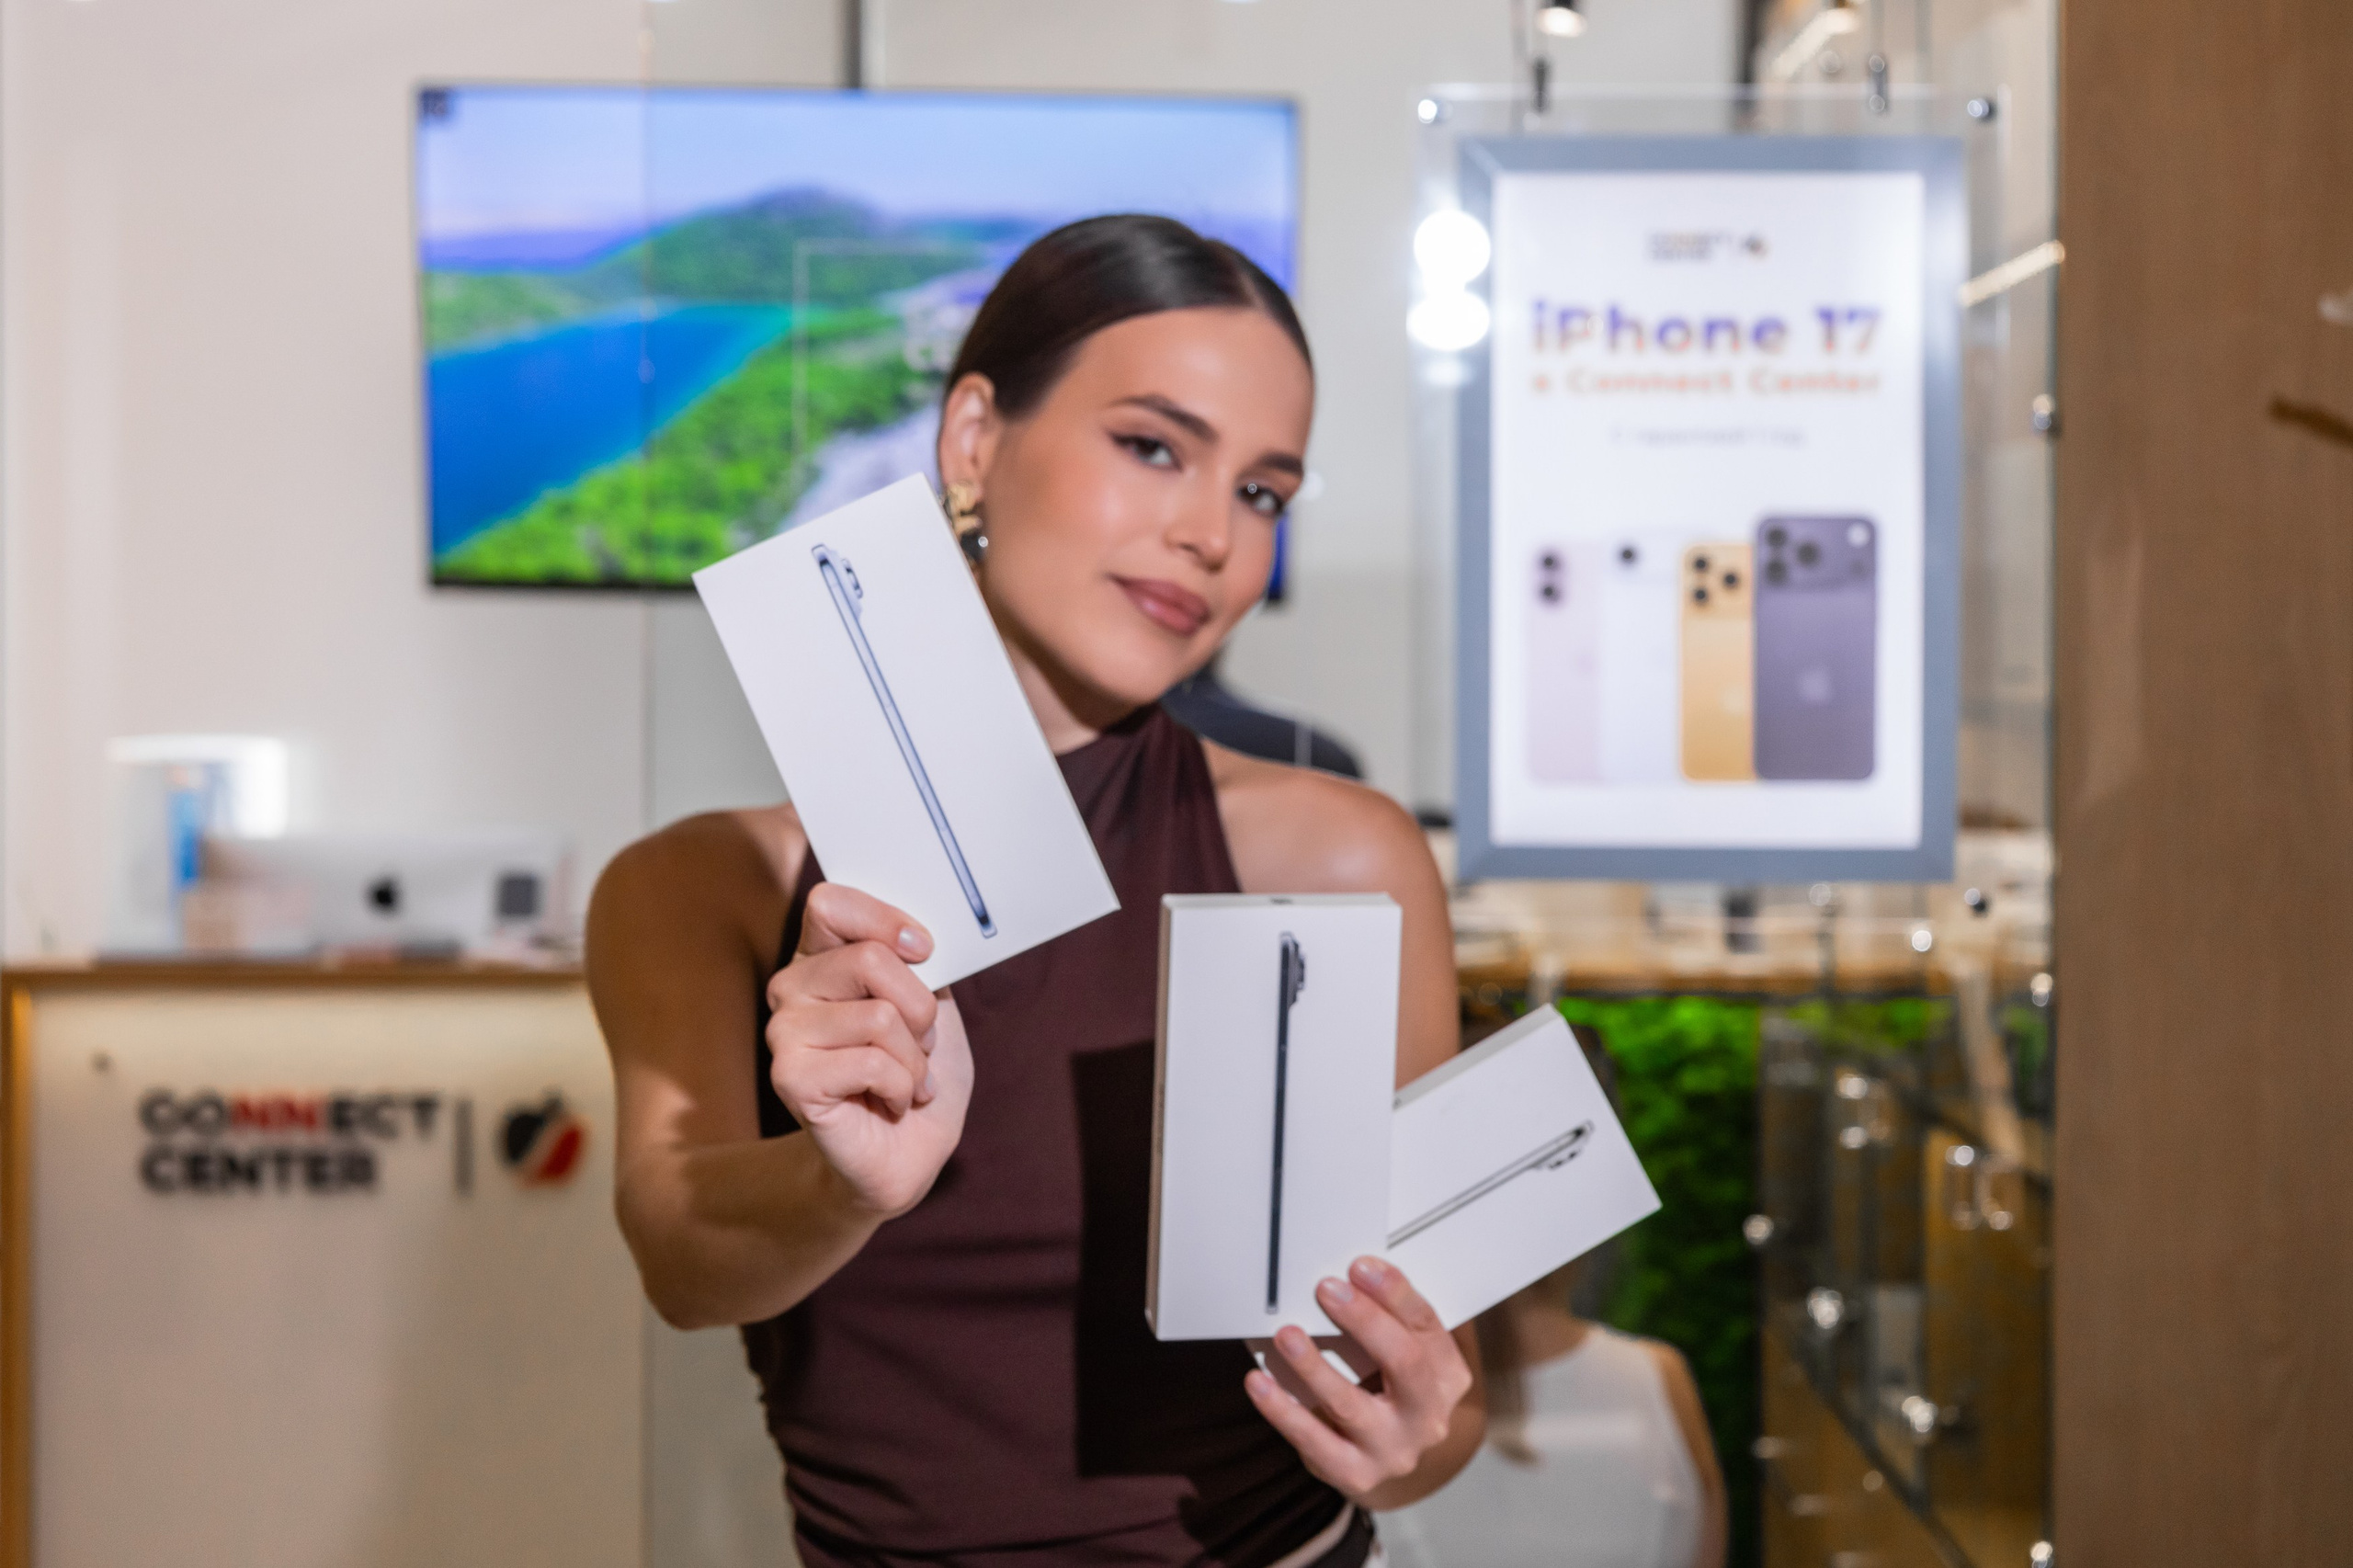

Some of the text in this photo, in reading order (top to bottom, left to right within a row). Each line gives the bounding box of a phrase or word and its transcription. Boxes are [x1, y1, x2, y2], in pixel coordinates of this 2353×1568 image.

[1533, 299, 1882, 354] iPhone 17
[139, 1089, 441, 1140] CONNECT
[139, 1144, 376, 1193] CENTER
